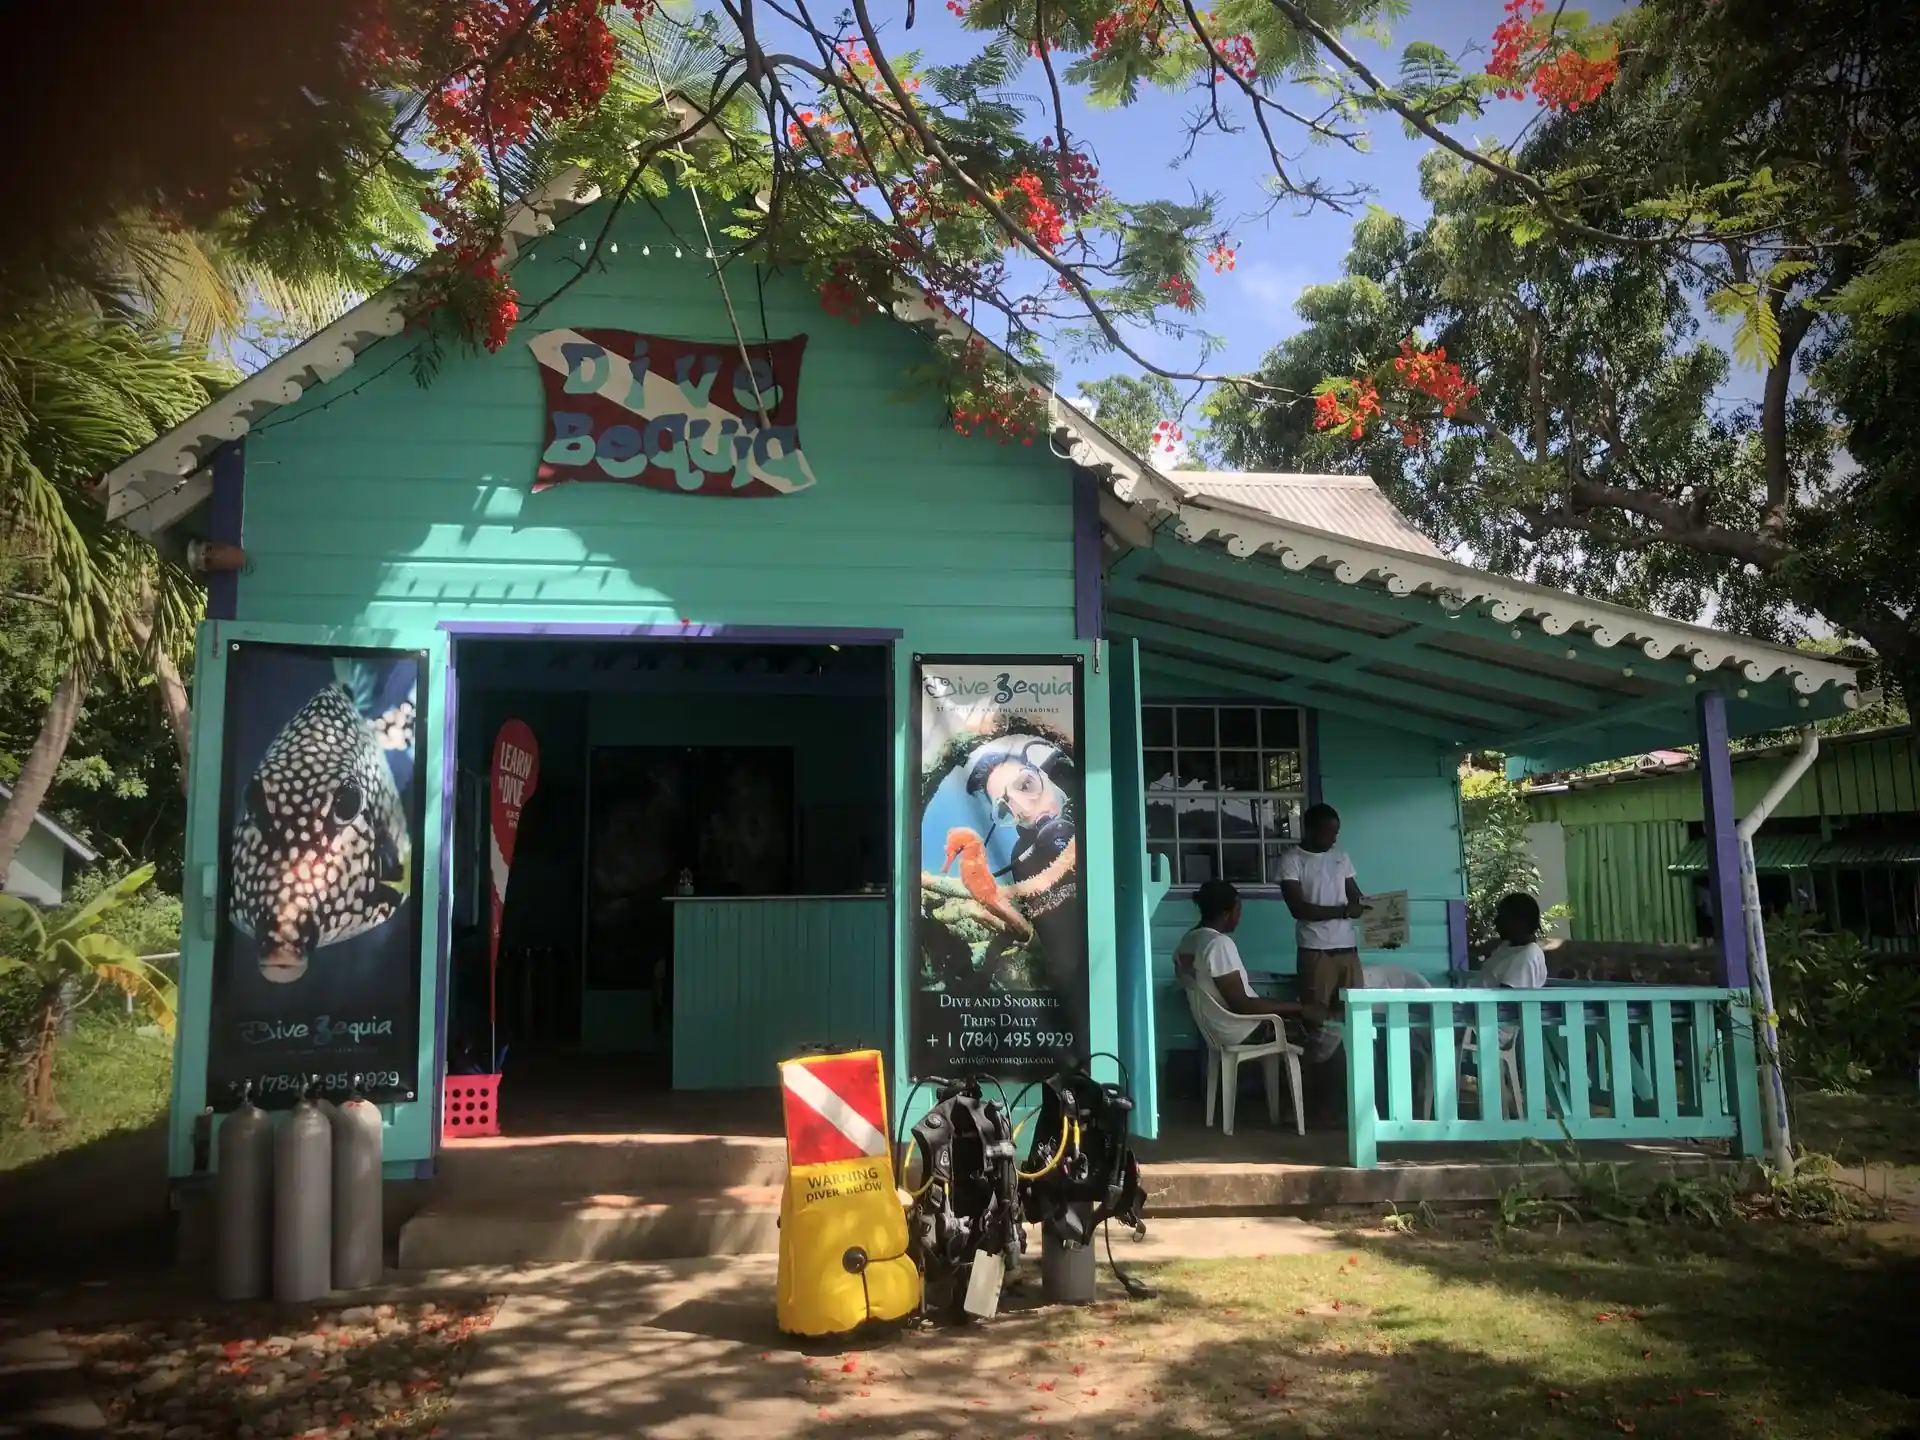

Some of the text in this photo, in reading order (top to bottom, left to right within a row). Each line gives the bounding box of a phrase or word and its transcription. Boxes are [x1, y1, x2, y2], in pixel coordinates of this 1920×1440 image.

[560, 338, 783, 412] Dive
[542, 412, 806, 491] Bequia
[923, 672, 1073, 704] Dive Bequia
[500, 741, 533, 780] LEARN
[502, 775, 525, 807] DIVE
[237, 1020, 309, 1044] Dive
[960, 1032, 999, 1051] (784)
[1003, 1032, 1032, 1047] 495
[1036, 1032, 1074, 1047] 9929
[806, 1180, 882, 1204] DIVER BELOW
[807, 1167, 879, 1189] WARNING
